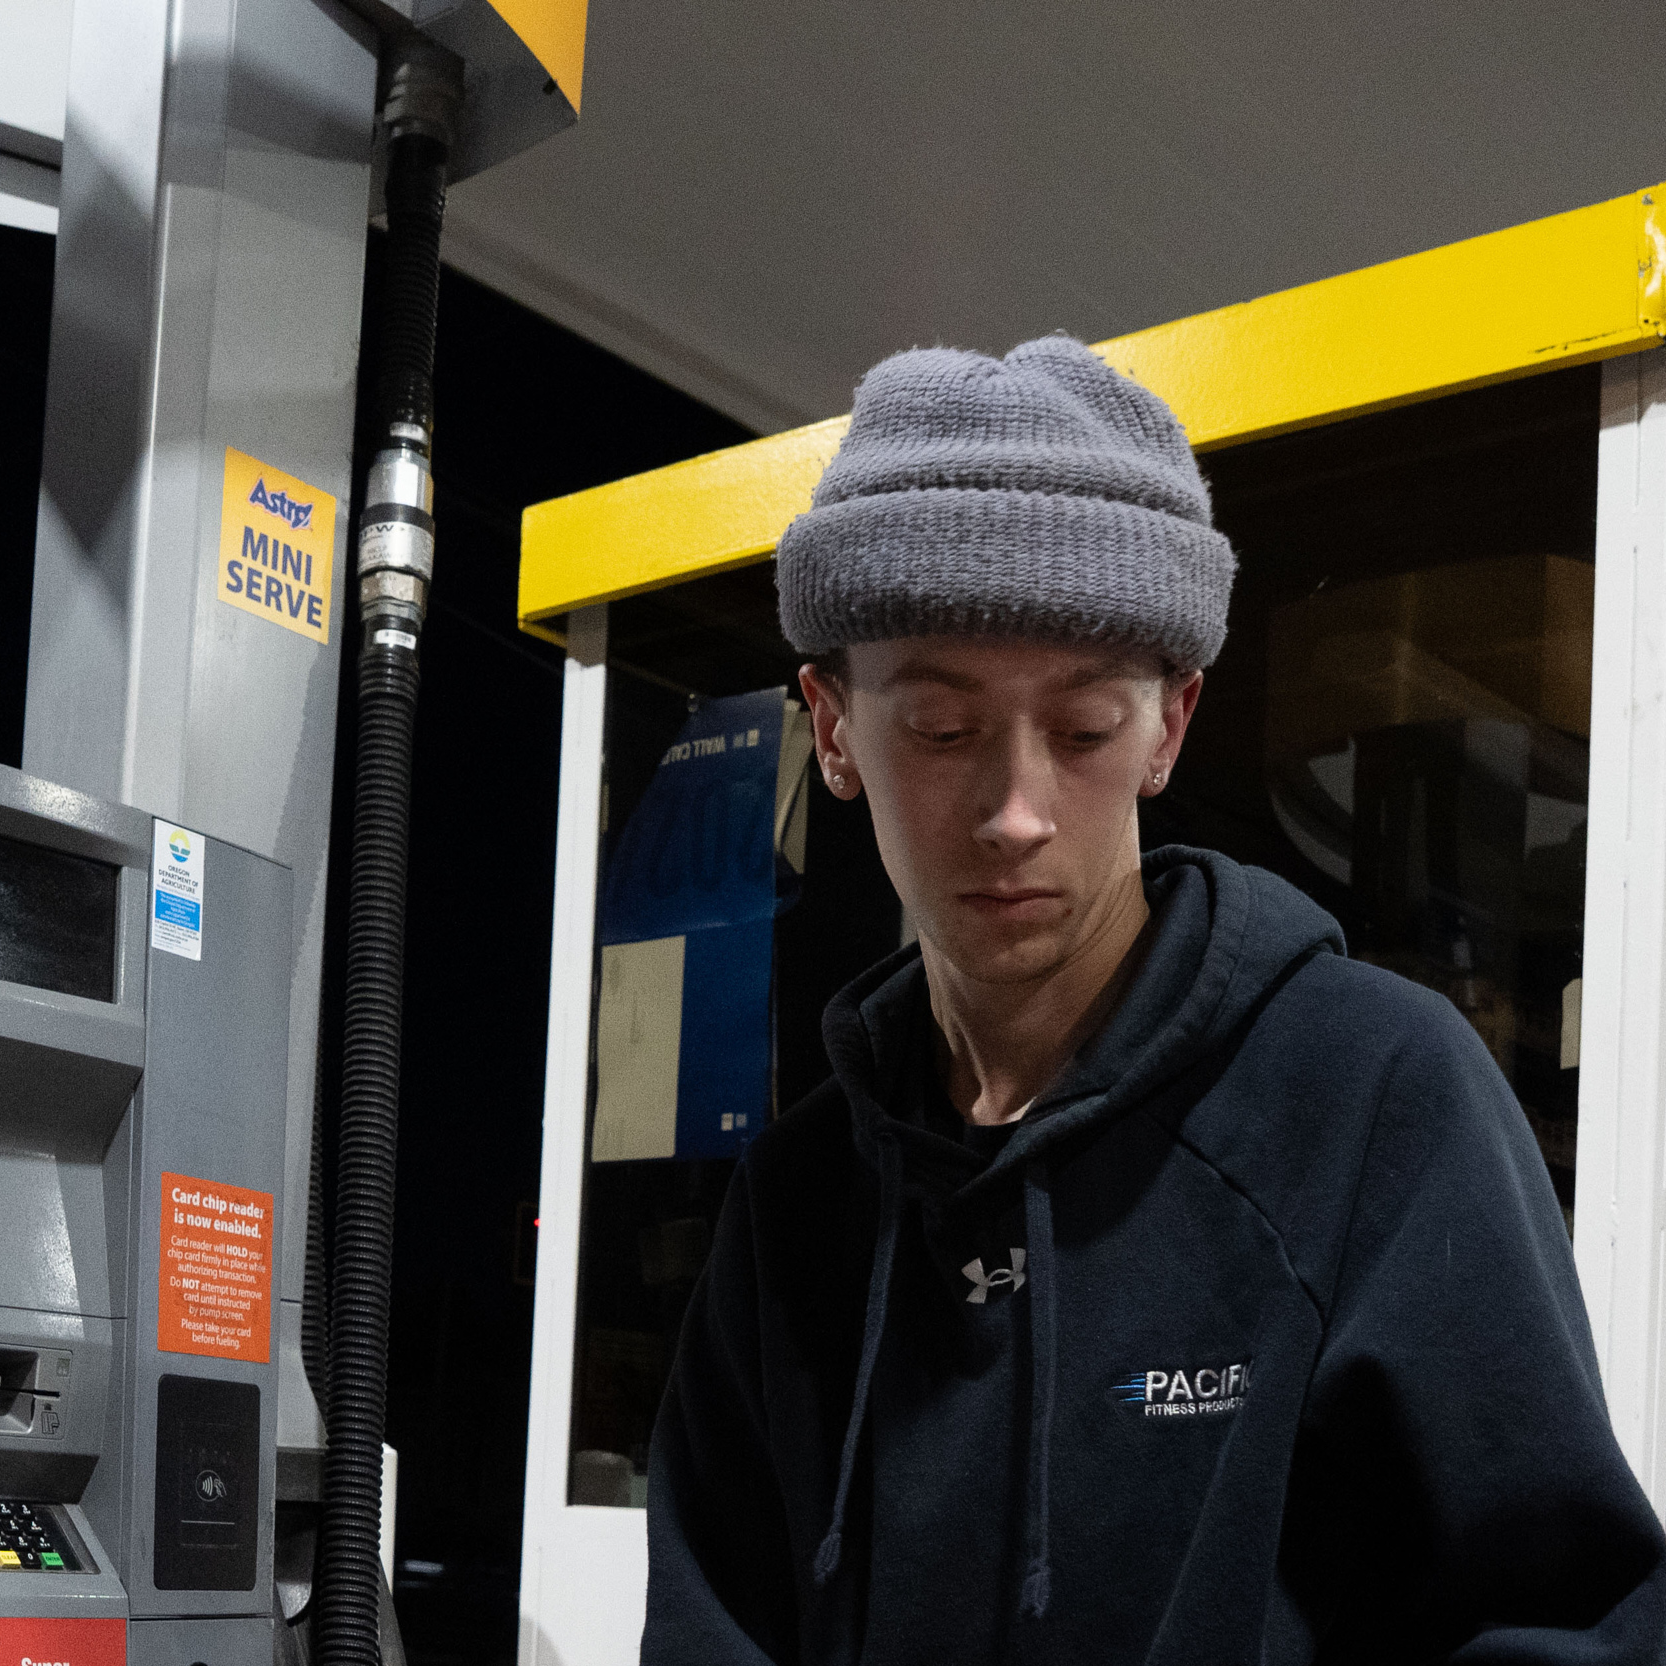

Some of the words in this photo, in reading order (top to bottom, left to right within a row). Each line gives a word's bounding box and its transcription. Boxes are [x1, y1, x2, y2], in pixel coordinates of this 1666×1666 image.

[241, 525, 312, 586] MINI
[226, 559, 323, 629] SERVE
[158, 868, 191, 886] DEPARTMENT
[191, 879, 199, 888] OF
[167, 864, 190, 878] OREGON
[161, 877, 196, 895] AGRICULTURE
[171, 1187, 201, 1207] Card
[202, 1193, 227, 1215] chip
[228, 1202, 265, 1219] reader
[173, 1208, 185, 1225] is
[186, 1214, 212, 1229] now
[213, 1218, 262, 1240] enabled.
[170, 1235, 189, 1247] Card
[189, 1239, 213, 1252] reader
[213, 1242, 226, 1254] will
[226, 1244, 248, 1258] HOLD
[248, 1250, 264, 1261] your
[167, 1247, 183, 1261] chip
[184, 1252, 201, 1262] card
[201, 1252, 222, 1267] firmly
[222, 1256, 229, 1266] in
[230, 1258, 248, 1271] place
[177, 1263, 218, 1280] authorizing
[218, 1269, 257, 1284] transaction.
[169, 1276, 181, 1288] Do
[182, 1278, 200, 1290] NOT
[200, 1282, 229, 1296] attempt
[229, 1286, 237, 1296] to
[238, 1289, 262, 1300] remove
[183, 1292, 200, 1303] card
[200, 1295, 217, 1306] until
[217, 1297, 251, 1311] instructed
[188, 1304, 198, 1317] by
[199, 1307, 221, 1320] pump
[181, 1318, 204, 1331] Please
[204, 1321, 220, 1334] take
[220, 1326, 236, 1337] your
[236, 1327, 251, 1338] card
[192, 1331, 215, 1345] before
[1144, 1402, 1196, 1417] FITNESS
